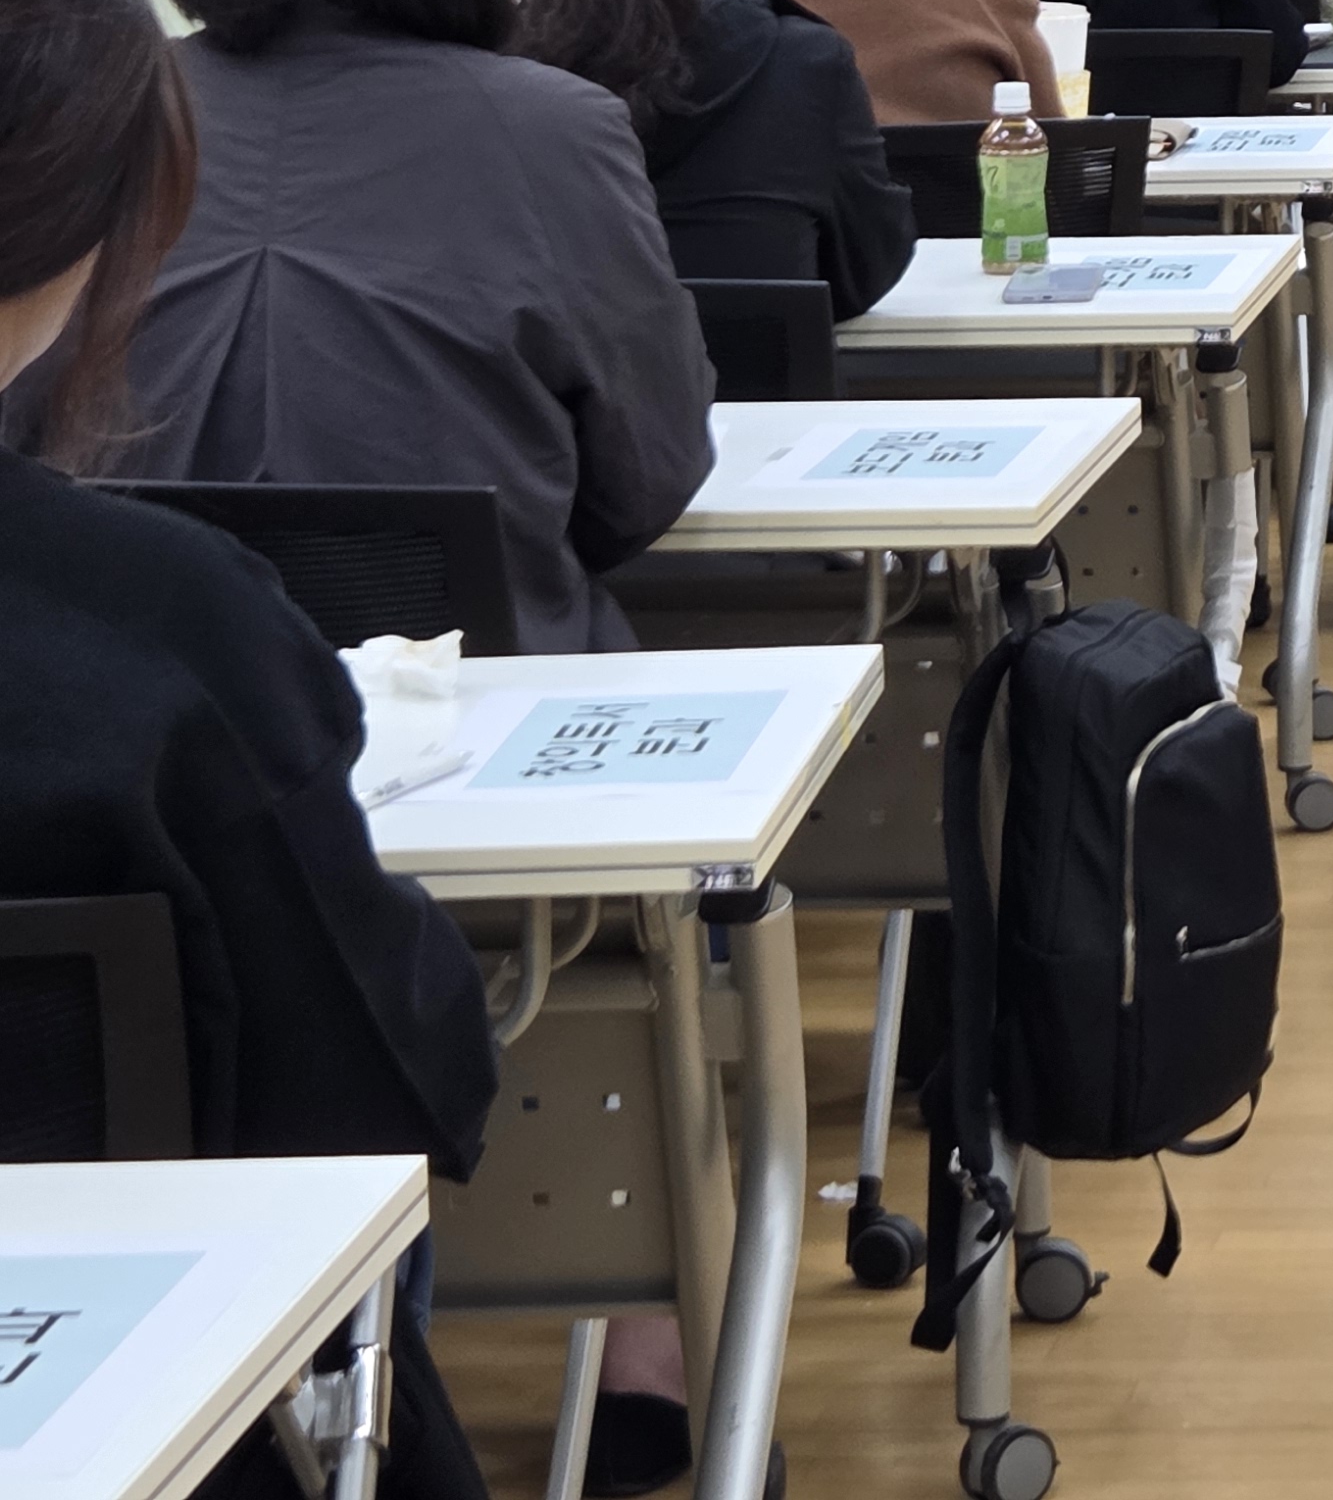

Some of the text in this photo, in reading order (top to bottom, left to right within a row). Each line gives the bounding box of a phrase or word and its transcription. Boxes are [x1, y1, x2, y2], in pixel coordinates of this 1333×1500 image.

[840, 431, 941, 475] 보드게임
[923, 440, 997, 463] 분과
[518, 702, 651, 778] 창의독서
[627, 716, 726, 757] 분과
[0, 1306, 84, 1386] 과
